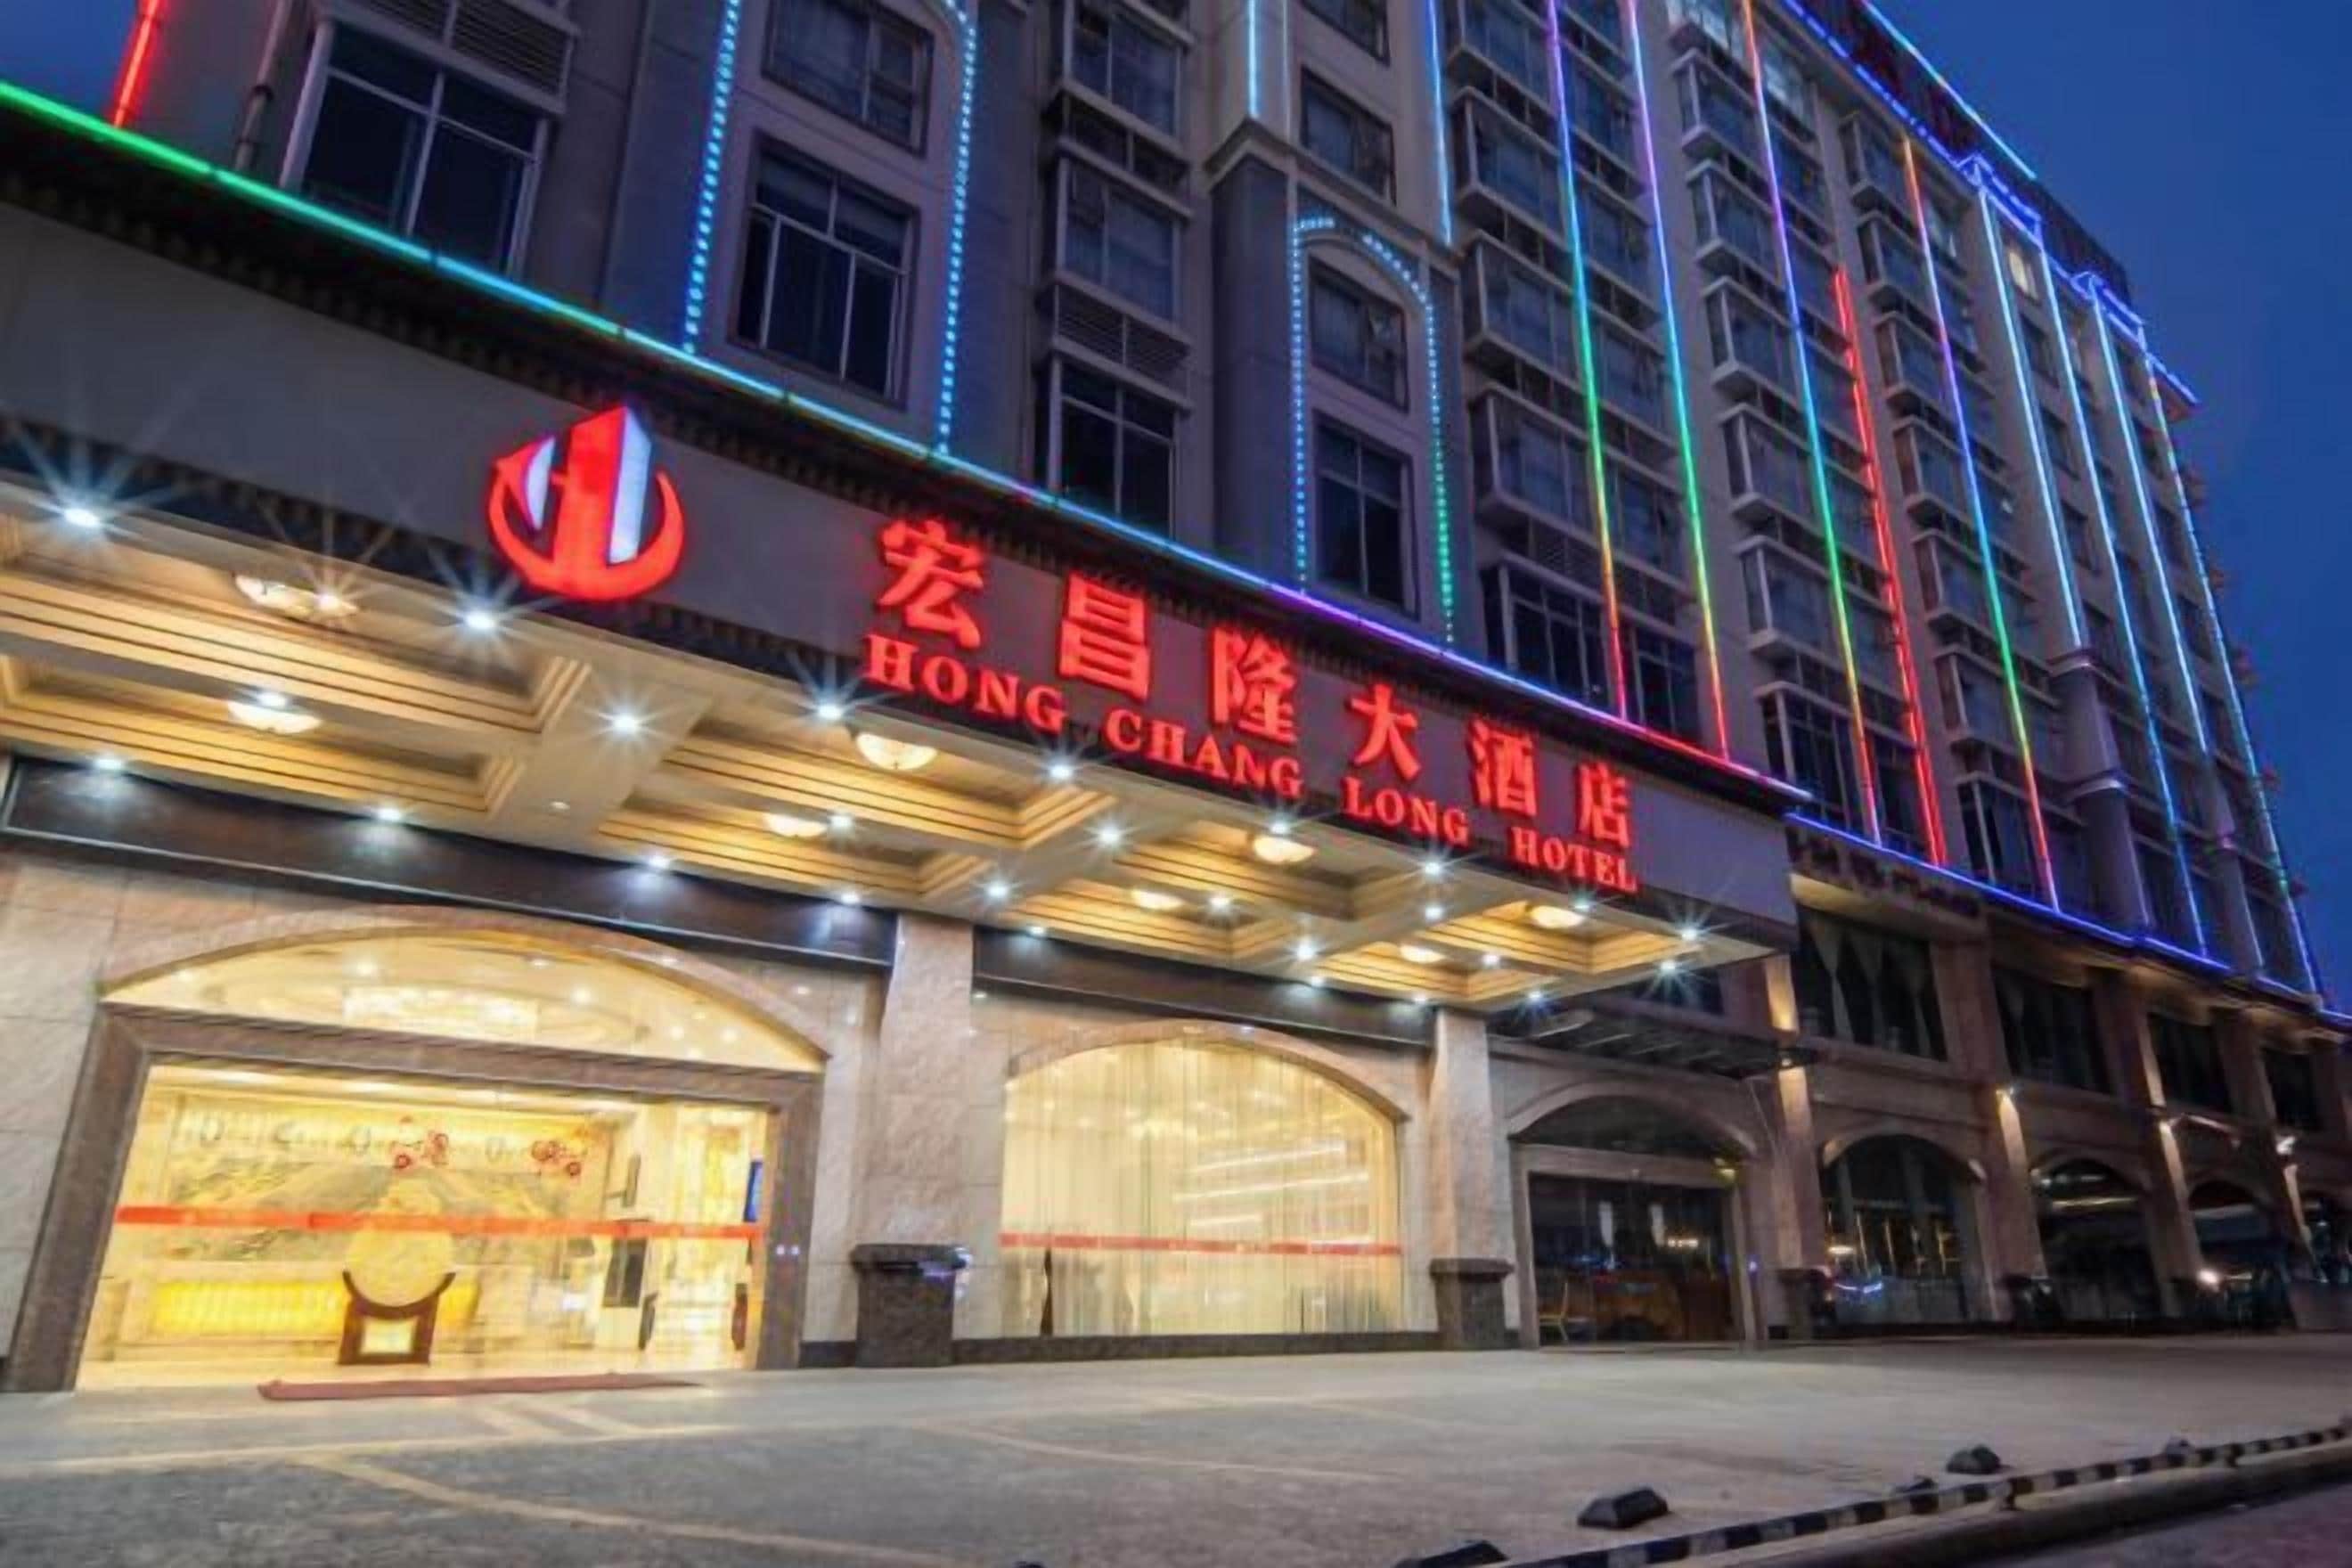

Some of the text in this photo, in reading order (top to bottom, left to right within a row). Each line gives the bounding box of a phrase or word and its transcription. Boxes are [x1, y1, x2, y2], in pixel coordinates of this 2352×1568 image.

[866, 632, 1637, 892] HONG CHANG LONG HOTEL
[878, 519, 1630, 849] 宏昌隆大酒店
